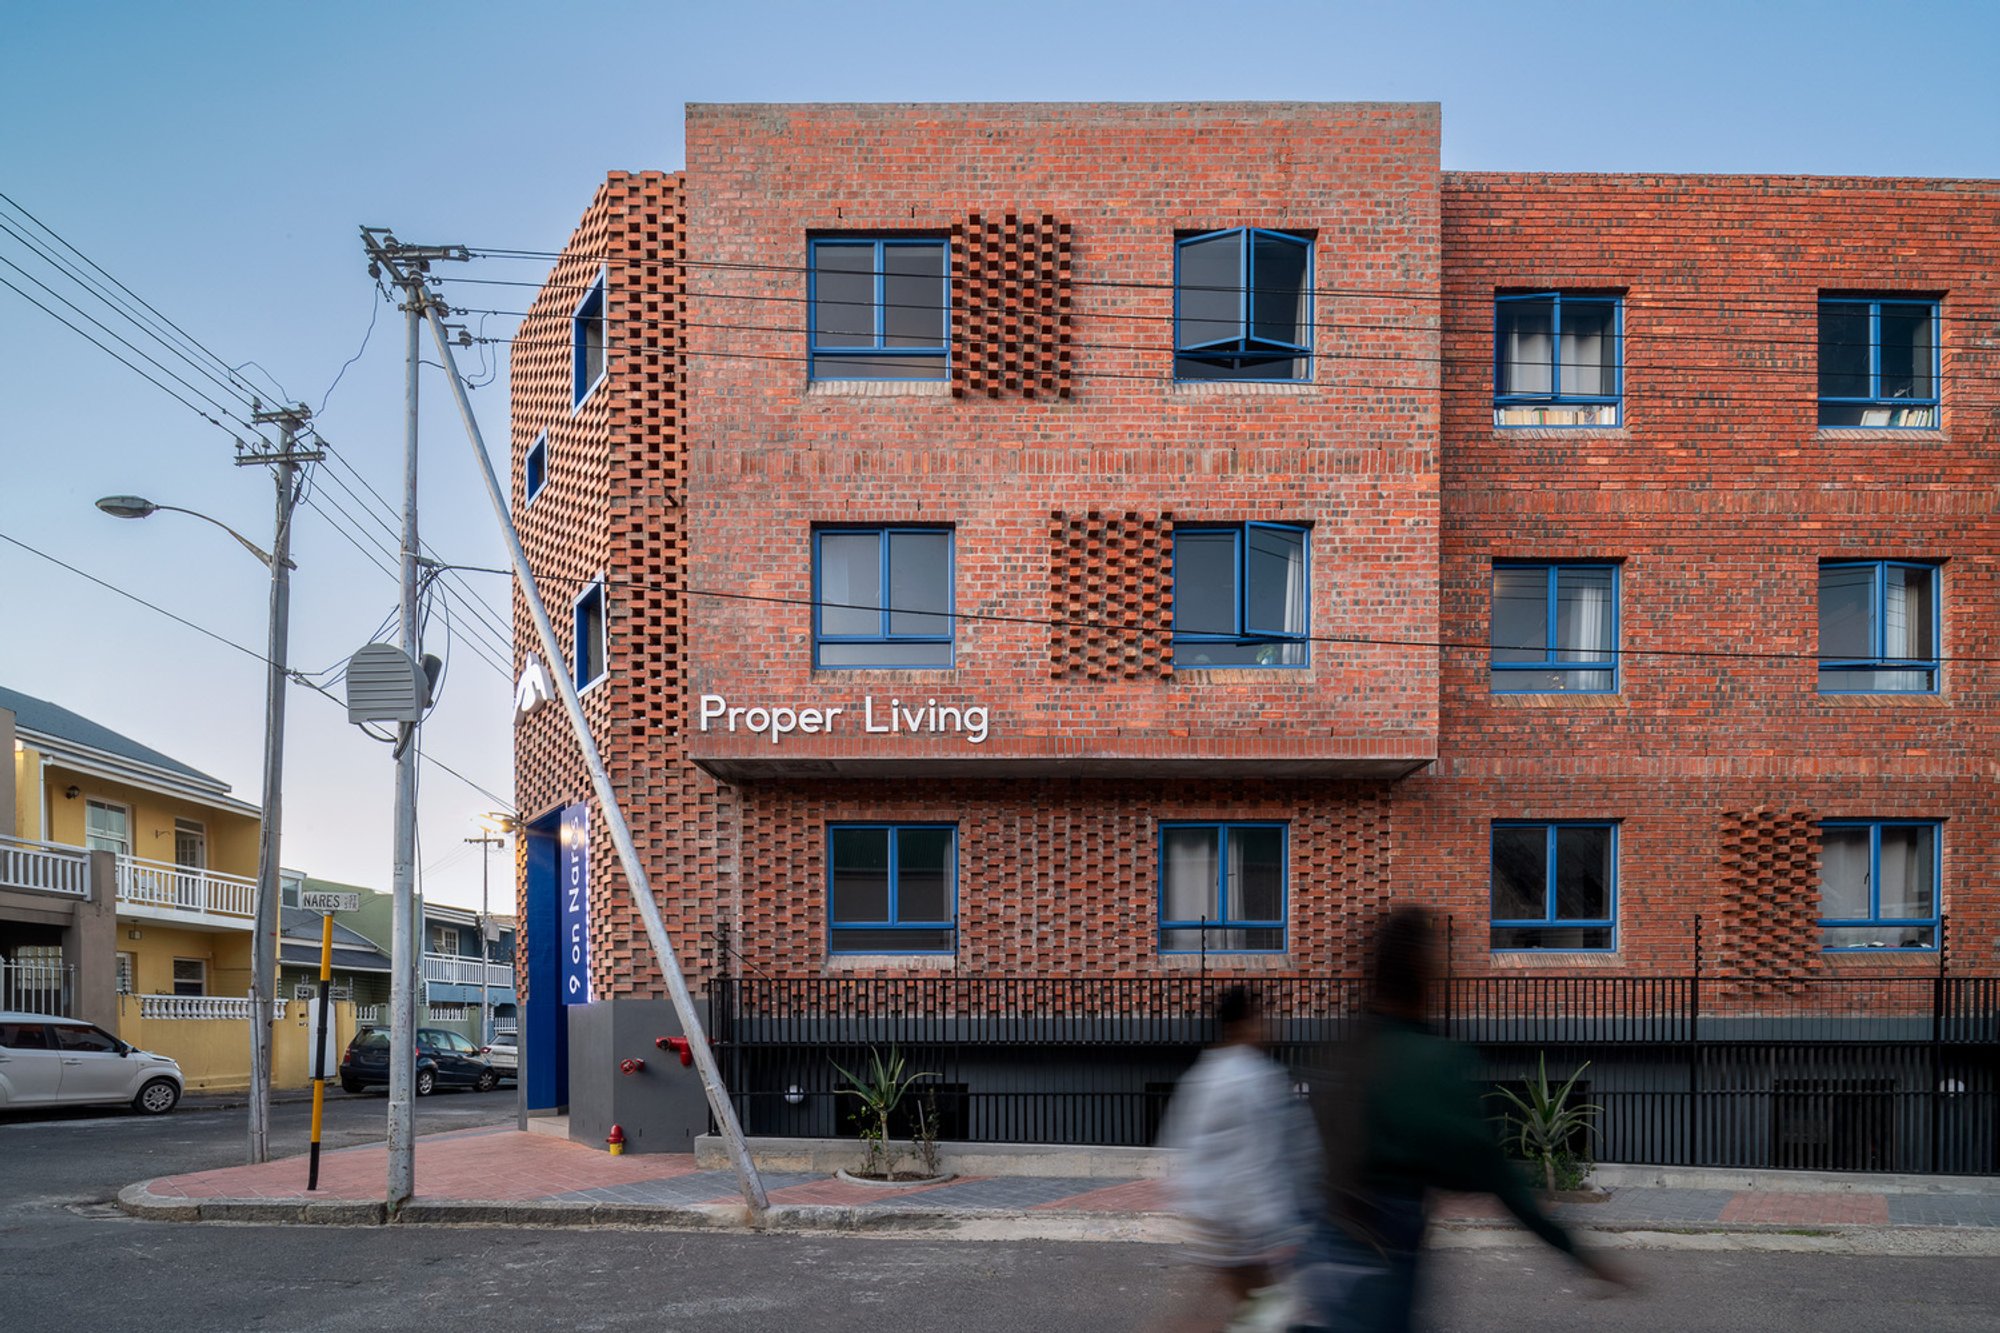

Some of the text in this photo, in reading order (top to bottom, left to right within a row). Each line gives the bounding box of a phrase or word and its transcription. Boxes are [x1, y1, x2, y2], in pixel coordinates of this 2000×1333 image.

[700, 694, 989, 744] Proper Living
[303, 894, 340, 908] NARES
[568, 816, 581, 995] 9 on Nares
